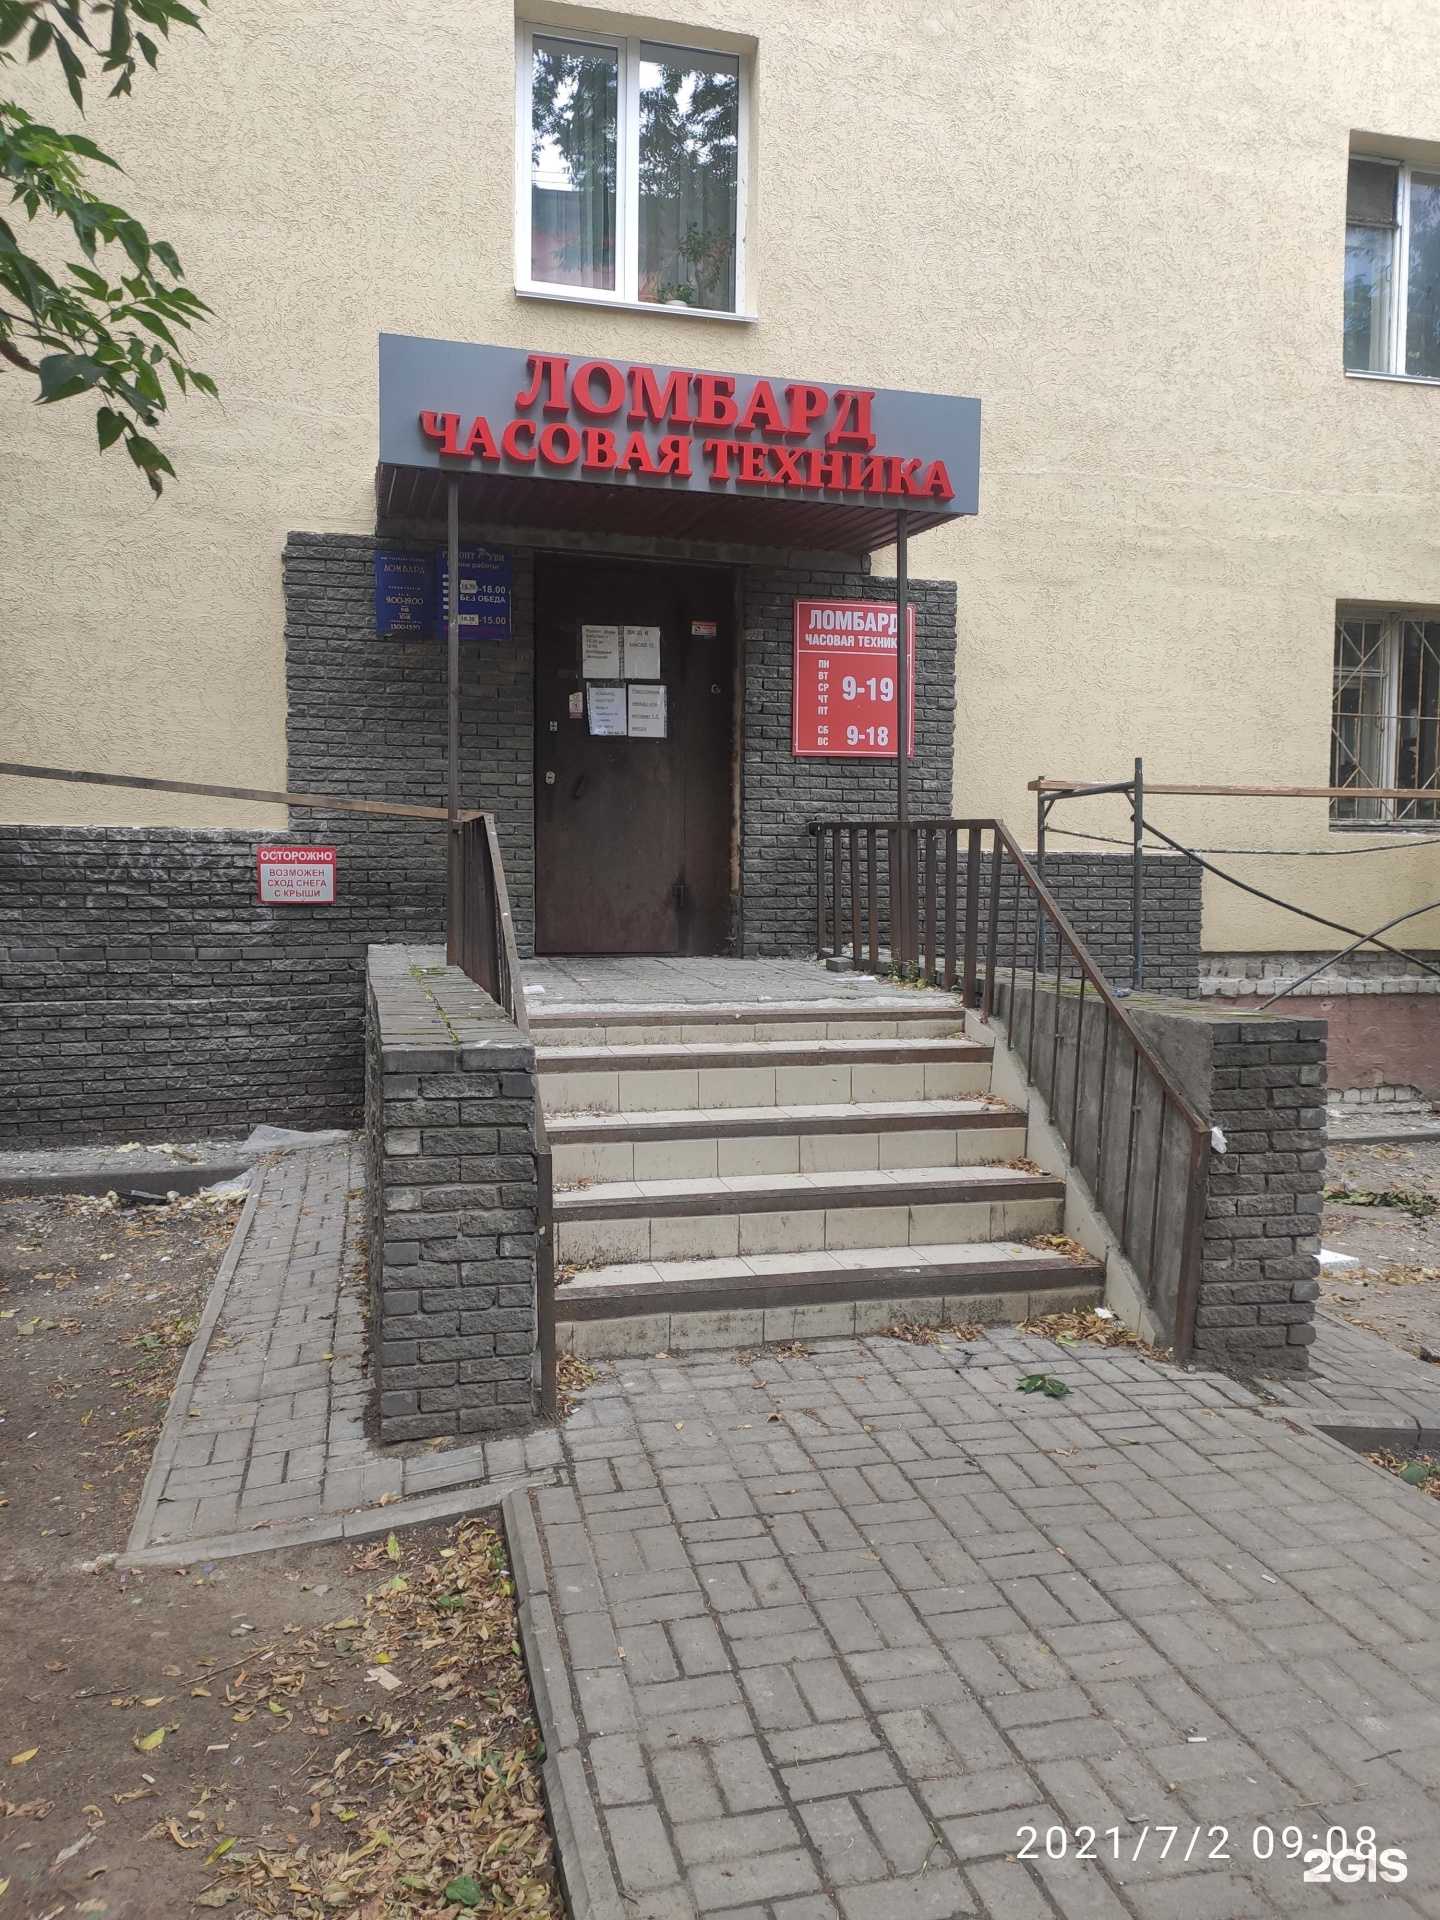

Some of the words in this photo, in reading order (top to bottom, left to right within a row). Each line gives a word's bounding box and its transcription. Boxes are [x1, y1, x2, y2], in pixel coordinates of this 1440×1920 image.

[514, 354, 876, 451] ЛОМБАРД
[420, 410, 692, 478] ЧАСОВАЯ
[704, 438, 955, 501] ТЕХНИКА
[477, 595, 506, 603] ОБЕДА
[805, 633, 855, 647] ЧАСОВАЯ
[858, 635, 898, 649] ТЕХНИК
[818, 659, 830, 669] ПН
[818, 671, 829, 680] ВТ
[818, 683, 830, 692] СР
[842, 675, 894, 702] 9-19
[818, 694, 829, 704] ЧТ
[817, 706, 829, 715] ПТ
[817, 725, 829, 734] СБ
[846, 725, 889, 746] 9-18
[817, 737, 829, 746] ВС
[260, 851, 333, 861] ОСТОРОЖНО
[269, 868, 325, 877] ВОЗМОЖЕН
[267, 879, 294, 888] СХОД
[296, 879, 327, 887] СНЕГА
[274, 889, 281, 897] С
[283, 889, 321, 897] КРЫШИ
